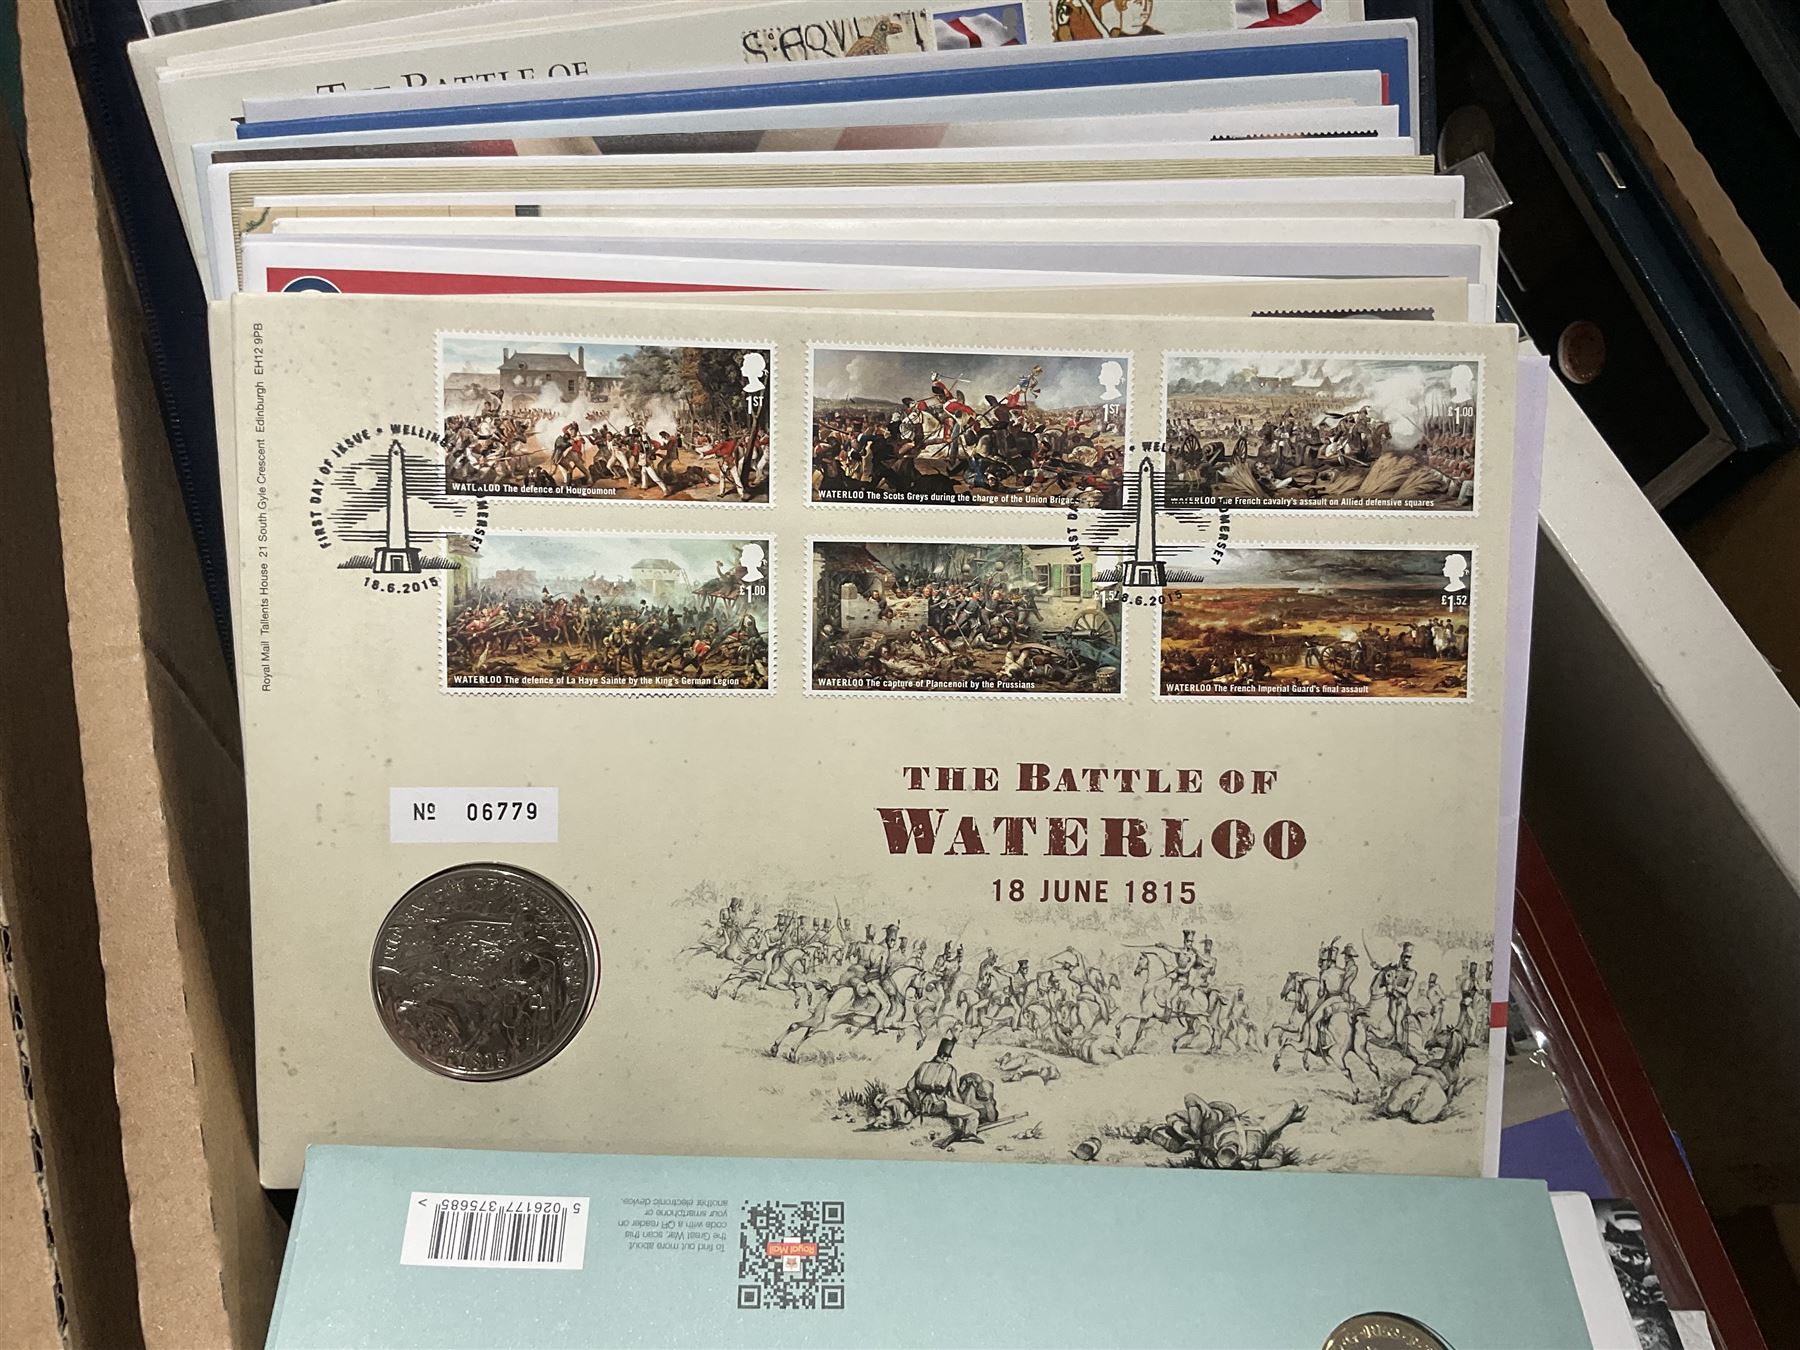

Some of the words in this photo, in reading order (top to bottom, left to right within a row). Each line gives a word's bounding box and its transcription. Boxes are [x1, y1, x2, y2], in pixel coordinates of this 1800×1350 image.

[253, 322, 263, 345] 9PB
[253, 348, 264, 375] EH12
[255, 381, 267, 433] Edinburgh
[745, 395, 764, 415] 1ST
[1102, 403, 1120, 422] 1ST
[331, 429, 371, 458] ISSUE
[256, 439, 266, 483] Crescent
[319, 458, 334, 475] OF
[310, 478, 325, 504] DAY
[503, 484, 518, 493] The
[520, 484, 555, 494] defence
[555, 485, 565, 494] of
[566, 485, 617, 496] Hougoumont
[257, 487, 269, 510] Gyle
[818, 490, 864, 499] WATERLOO
[866, 491, 881, 500] The
[883, 491, 905, 500] Scots
[907, 492, 928, 502] Greys
[931, 492, 956, 503] during
[957, 493, 970, 502] the
[972, 493, 999, 504] charge
[1001, 494, 1009, 503] of
[1010, 494, 1023, 503] the
[1025, 495, 1048, 504] Union
[1235, 496, 1261, 505] French
[1263, 497, 1298, 507] cavalry's
[1299, 498, 1327, 506] assault
[1341, 498, 1362, 506] Allied
[1365, 498, 1402, 506] defensive
[1404, 500, 1435, 508] squares
[257, 514, 268, 542] South
[310, 511, 332, 549] FIRST
[1067, 527, 1085, 564] FIRST
[258, 546, 268, 558] 21
[259, 563, 269, 595] House
[363, 576, 439, 594] 18.6.2015
[739, 585, 766, 603] £1.00
[1441, 594, 1467, 613] £1.52
[260, 598, 270, 636] Tallents
[260, 641, 270, 662] Mail
[262, 664, 273, 692] Royal
[454, 675, 502, 684] WATERLOO
[504, 676, 519, 684] The
[521, 676, 554, 685] defence
[556, 676, 565, 685] of
[566, 676, 576, 685] La
[578, 676, 598, 686] Haye
[600, 676, 626, 685] Sainte
[628, 676, 638, 686] by
[640, 677, 653, 685] the
[655, 677, 679, 687] King's
[681, 677, 711, 685] German
[713, 677, 739, 687] Legion
[818, 678, 864, 687] WATERLOO
[865, 679, 880, 687] The
[883, 679, 913, 689] capture
[915, 679, 924, 688] of
[926, 680, 968, 688] Plancenoit
[970, 680, 980, 690] by
[981, 680, 995, 688] the
[997, 680, 1035, 689] Prussians
[1166, 683, 1212, 692] WATERLOO
[1213, 684, 1227, 692] The
[1229, 684, 1256, 692] French
[1258, 684, 1290, 694] Imperial
[1291, 685, 1320, 693] Guard's
[1322, 685, 1339, 693] final
[1341, 685, 1369, 693] assault
[902, 765, 999, 791] THE
[1218, 769, 1278, 795] OF
[467, 802, 538, 821] 06779
[993, 879, 1025, 902] 18
[1040, 879, 1109, 903] JUNE
[1125, 880, 1196, 905] 1815
[441, 1199, 498, 1212] 375685
[506, 1201, 561, 1214] 026177
[573, 1202, 582, 1214] 5
[653, 1198, 694, 1207] electronic
[696, 1199, 728, 1208] another
[655, 1208, 707, 1218] smartphone
[709, 1209, 728, 1218] your
[617, 1219, 630, 1227] on
[631, 1219, 659, 1228] reader
[661, 1220, 676, 1230] QR
[685, 1220, 703, 1229] with
[705, 1220, 727, 1229] code
[624, 1230, 640, 1239] this
[642, 1231, 663, 1239] scan
[687, 1231, 711, 1240] Great
[712, 1232, 727, 1241] the
[629, 1241, 655, 1250] about
[656, 1242, 679, 1250] more
[681, 1242, 696, 1251] out
[697, 1242, 714, 1252] find
[715, 1242, 725, 1252] To
[790, 1244, 815, 1254] Royal
